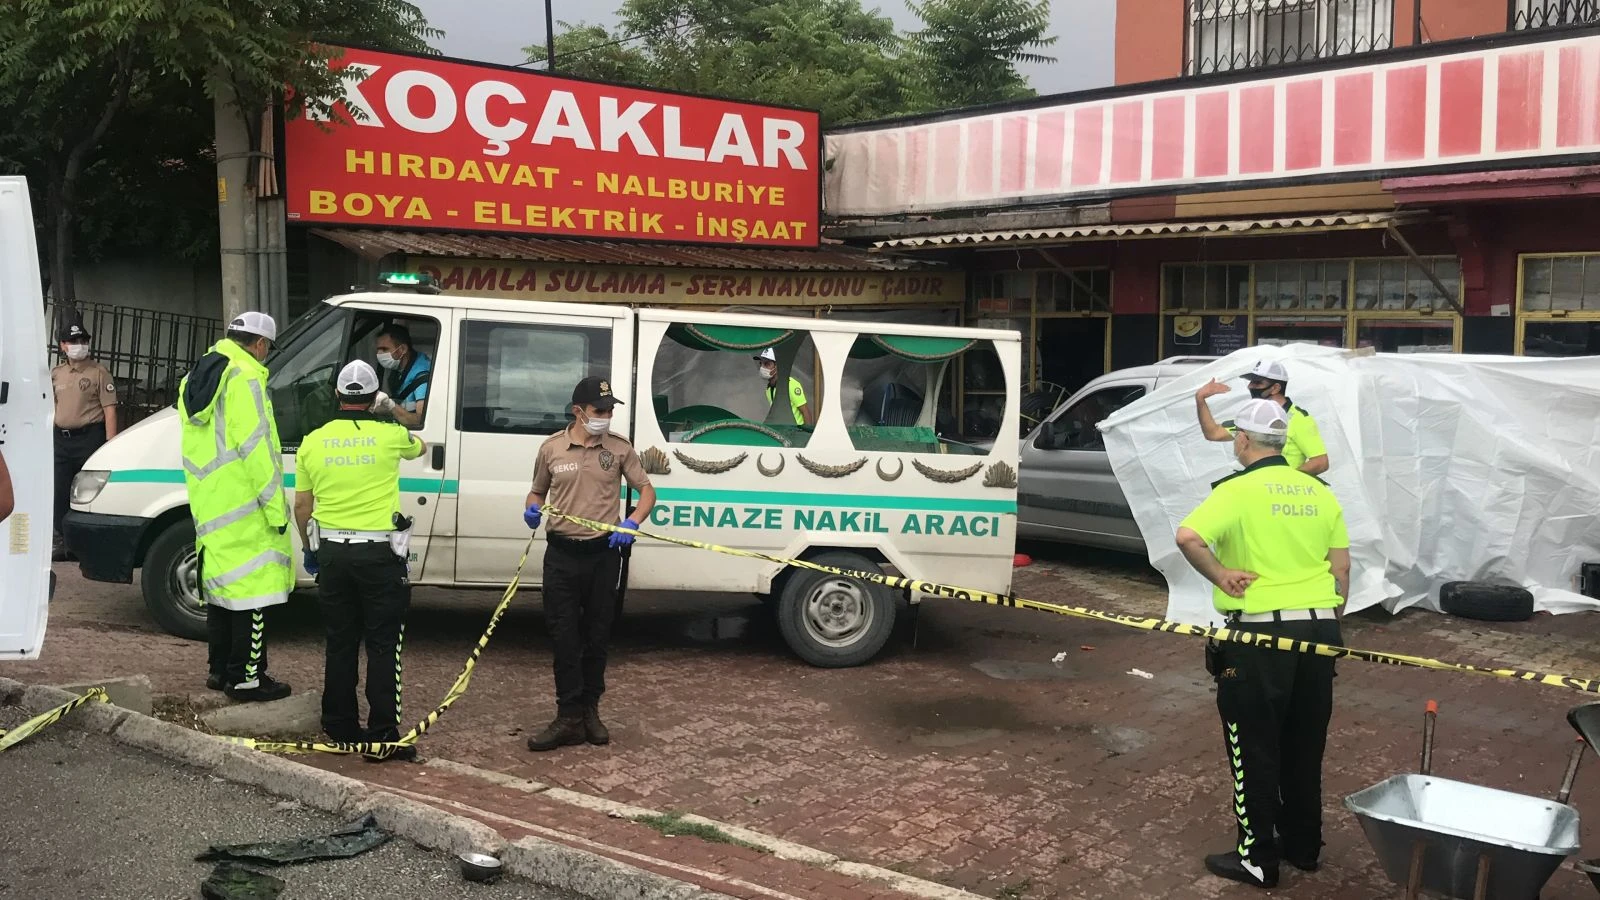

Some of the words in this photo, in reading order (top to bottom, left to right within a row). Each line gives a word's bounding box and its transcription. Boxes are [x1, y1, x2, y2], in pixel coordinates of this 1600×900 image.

[346, 149, 559, 188] HIRDAVAT
[597, 172, 784, 206] NALBURİYE
[309, 190, 432, 220] BOYA
[474, 201, 663, 233] ELEKTRİK
[696, 214, 807, 241] İNŞAAT
[544, 270, 666, 295] SULAMA
[686, 274, 752, 298] SERA
[757, 275, 866, 298] NAYLONU
[322, 436, 377, 449] TRAFİK
[323, 454, 376, 468] POLİSİ
[1263, 482, 1317, 498] TRAFİK
[649, 504, 783, 530] CENAZE
[793, 509, 889, 533] NAKİL
[901, 513, 1000, 538] ARACI
[1271, 503, 1319, 518] POLİSİ
